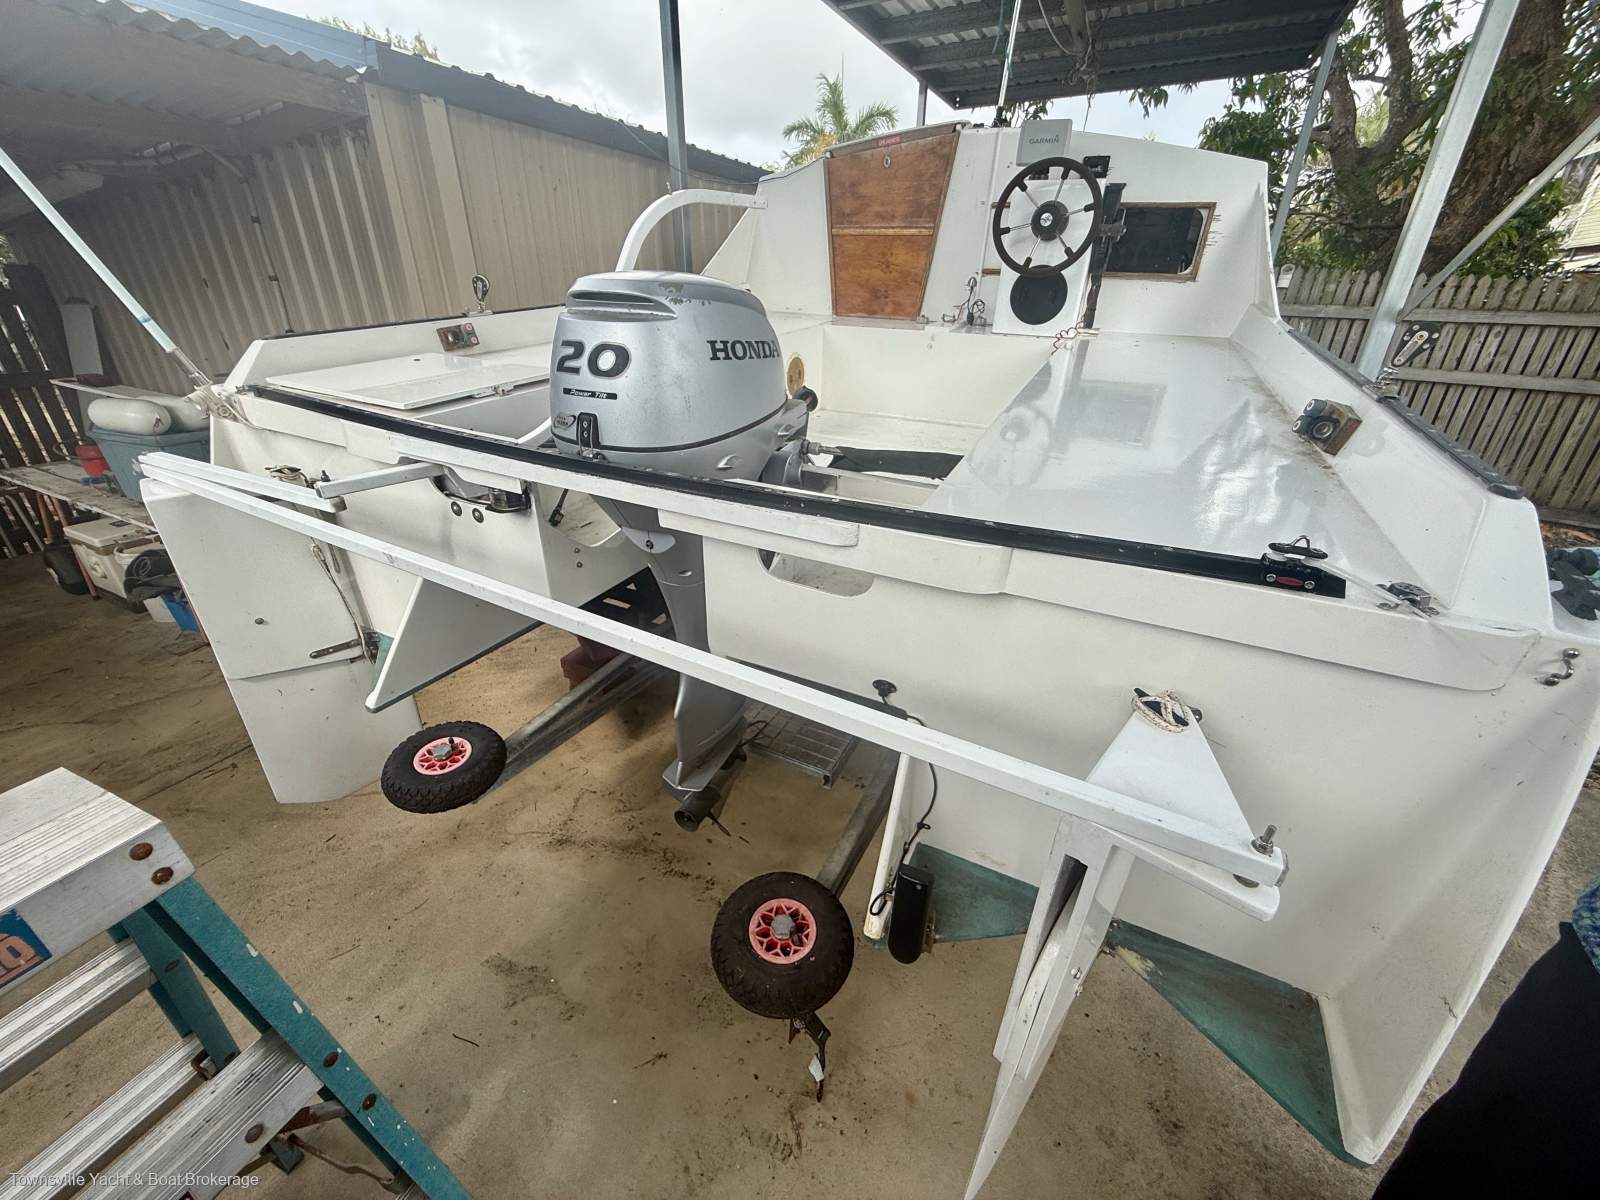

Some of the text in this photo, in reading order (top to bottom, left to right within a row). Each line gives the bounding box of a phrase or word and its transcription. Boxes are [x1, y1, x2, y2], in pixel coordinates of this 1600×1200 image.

[1029, 136, 1059, 145] GARMIN
[706, 339, 780, 361] HONDA
[556, 340, 630, 378] 20
[570, 389, 592, 397] Power
